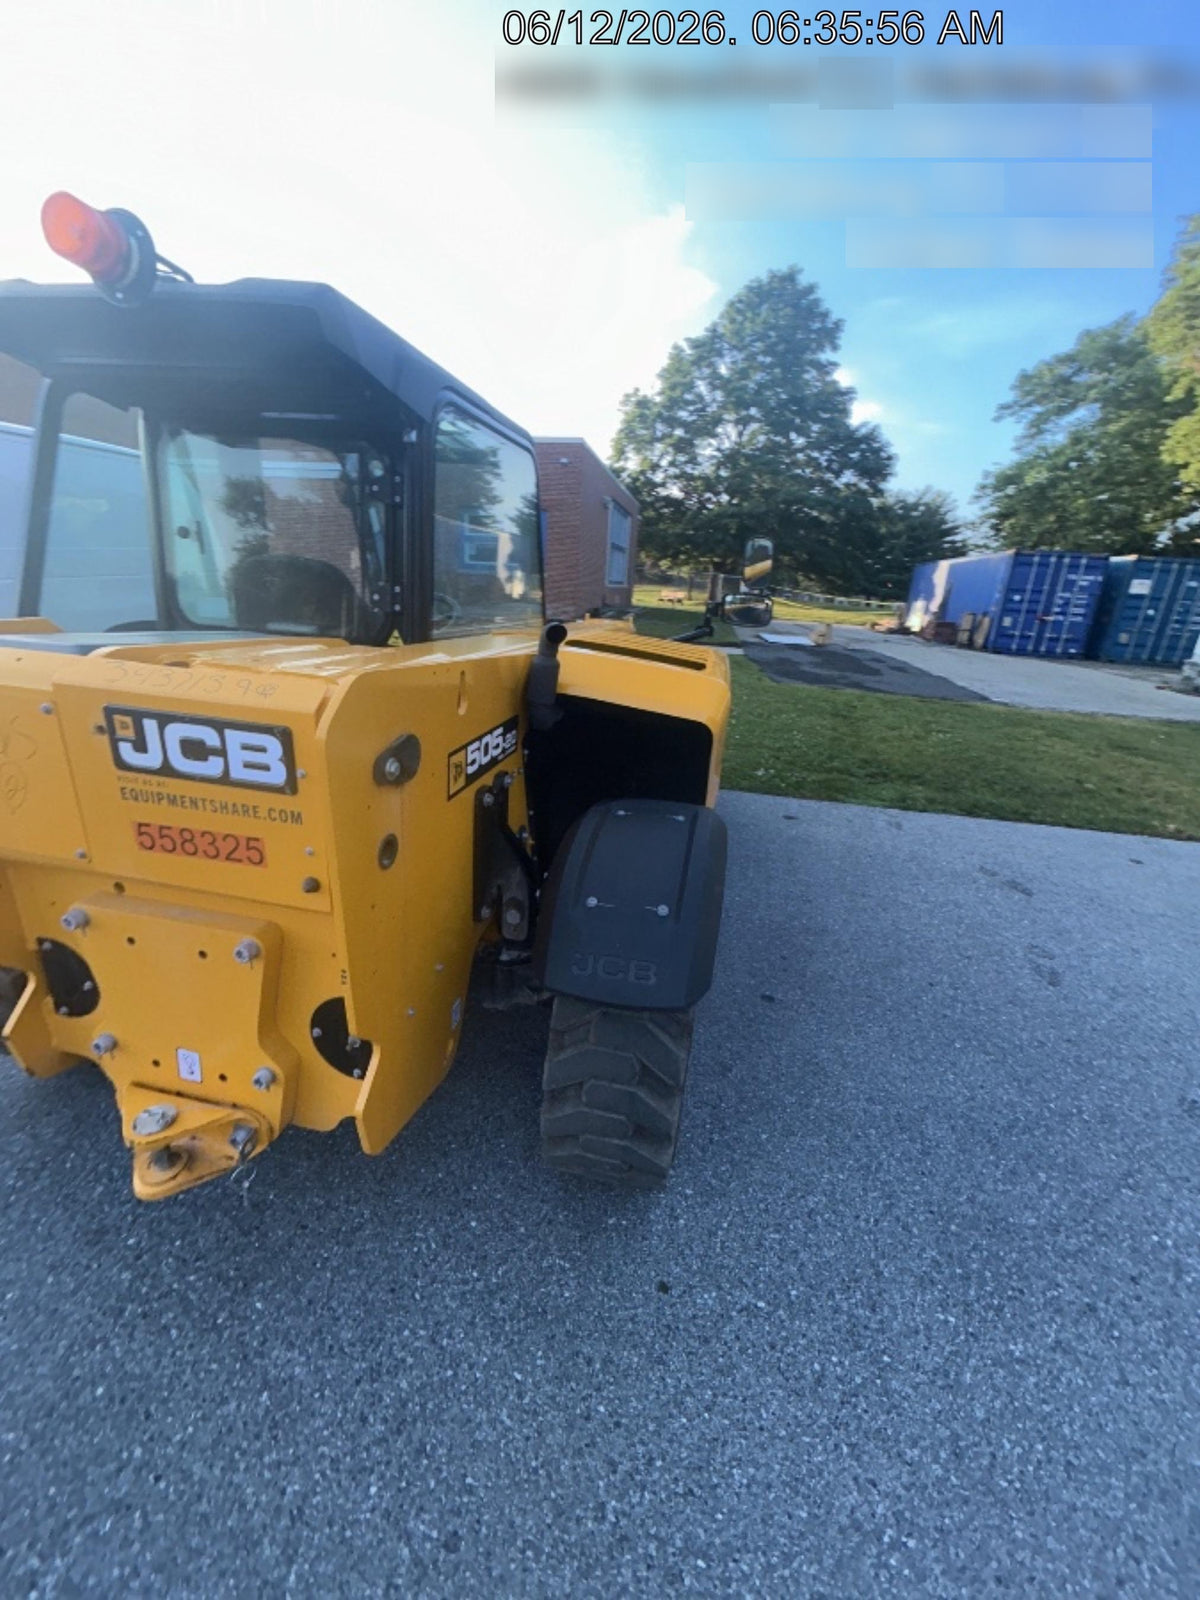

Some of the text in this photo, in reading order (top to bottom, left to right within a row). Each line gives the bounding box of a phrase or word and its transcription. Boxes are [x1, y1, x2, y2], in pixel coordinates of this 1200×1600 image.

[117, 717, 287, 787] JCB
[120, 786, 304, 825] EQUIPMENTSHARE.COM
[136, 822, 265, 866] 558325
[572, 953, 657, 986] JCB
